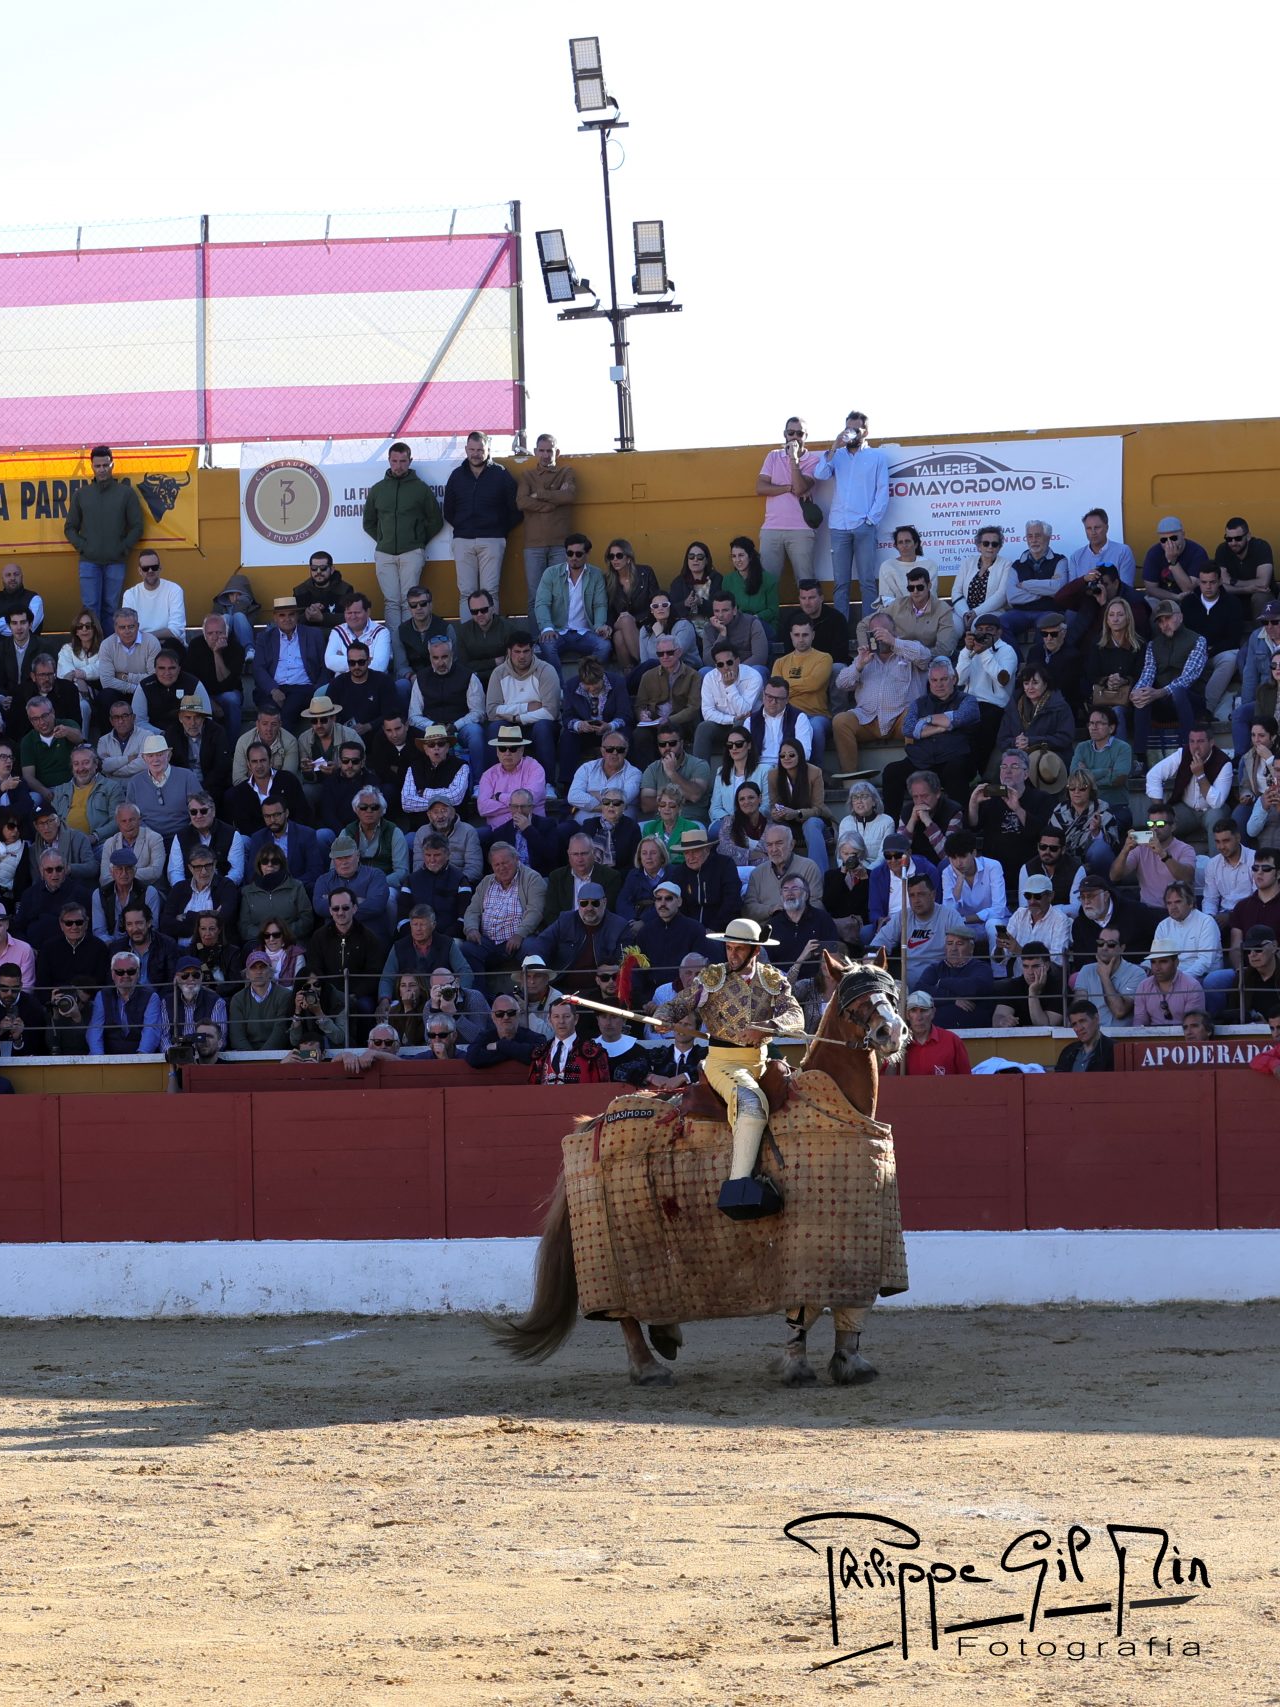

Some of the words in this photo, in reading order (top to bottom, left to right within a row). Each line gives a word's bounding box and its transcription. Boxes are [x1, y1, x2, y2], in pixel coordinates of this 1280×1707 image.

[280, 461, 319, 480] TAURINO
[913, 462, 977, 476] TALLERES
[1041, 476, 1070, 490] S.L.
[344, 487, 356, 500] LA
[930, 501, 958, 510] CHAPA
[967, 499, 1002, 508] PINTURA
[931, 508, 1001, 519] MANTENIMIENTO
[951, 519, 967, 527] PRE
[968, 519, 981, 527] ITV
[273, 531, 309, 542] PUYAZOS
[1010, 535, 1021, 543] DE
[939, 547, 957, 555] UTIEL
[911, 929, 933, 939] NIKE
[607, 1110, 652, 1121] QUASIMODO
